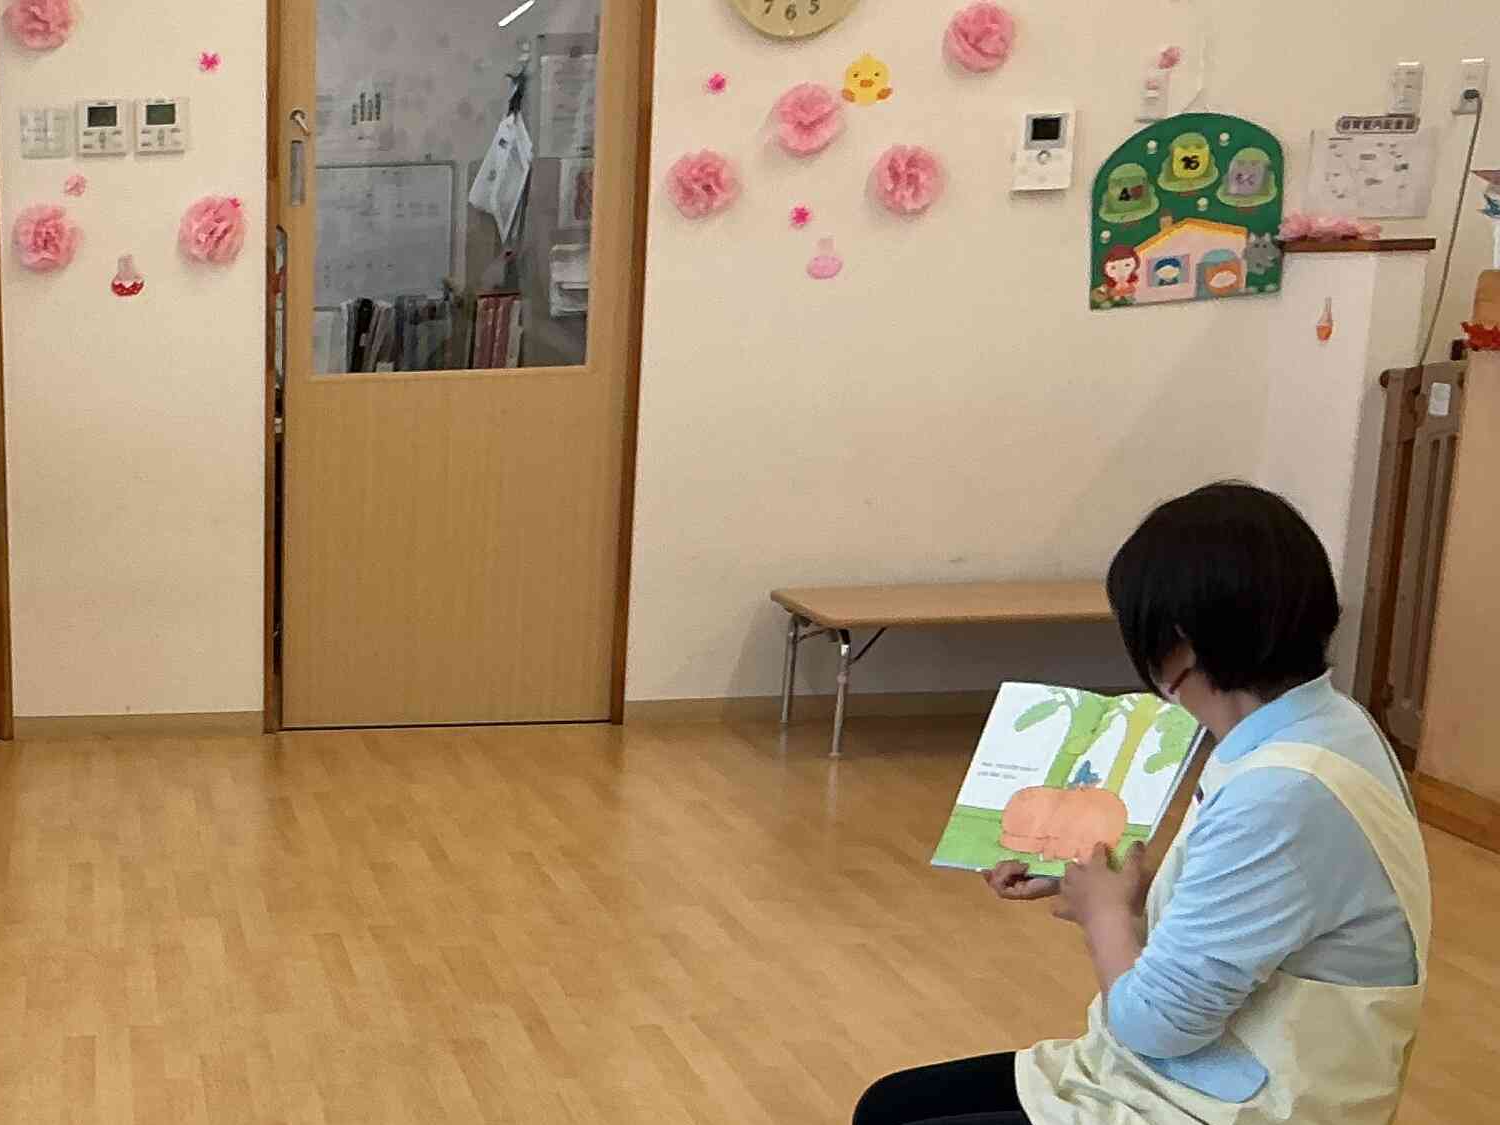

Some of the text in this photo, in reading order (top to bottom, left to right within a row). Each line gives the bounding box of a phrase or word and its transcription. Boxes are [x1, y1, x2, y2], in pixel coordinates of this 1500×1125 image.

[763, 0, 820, 21] 7 6 5
